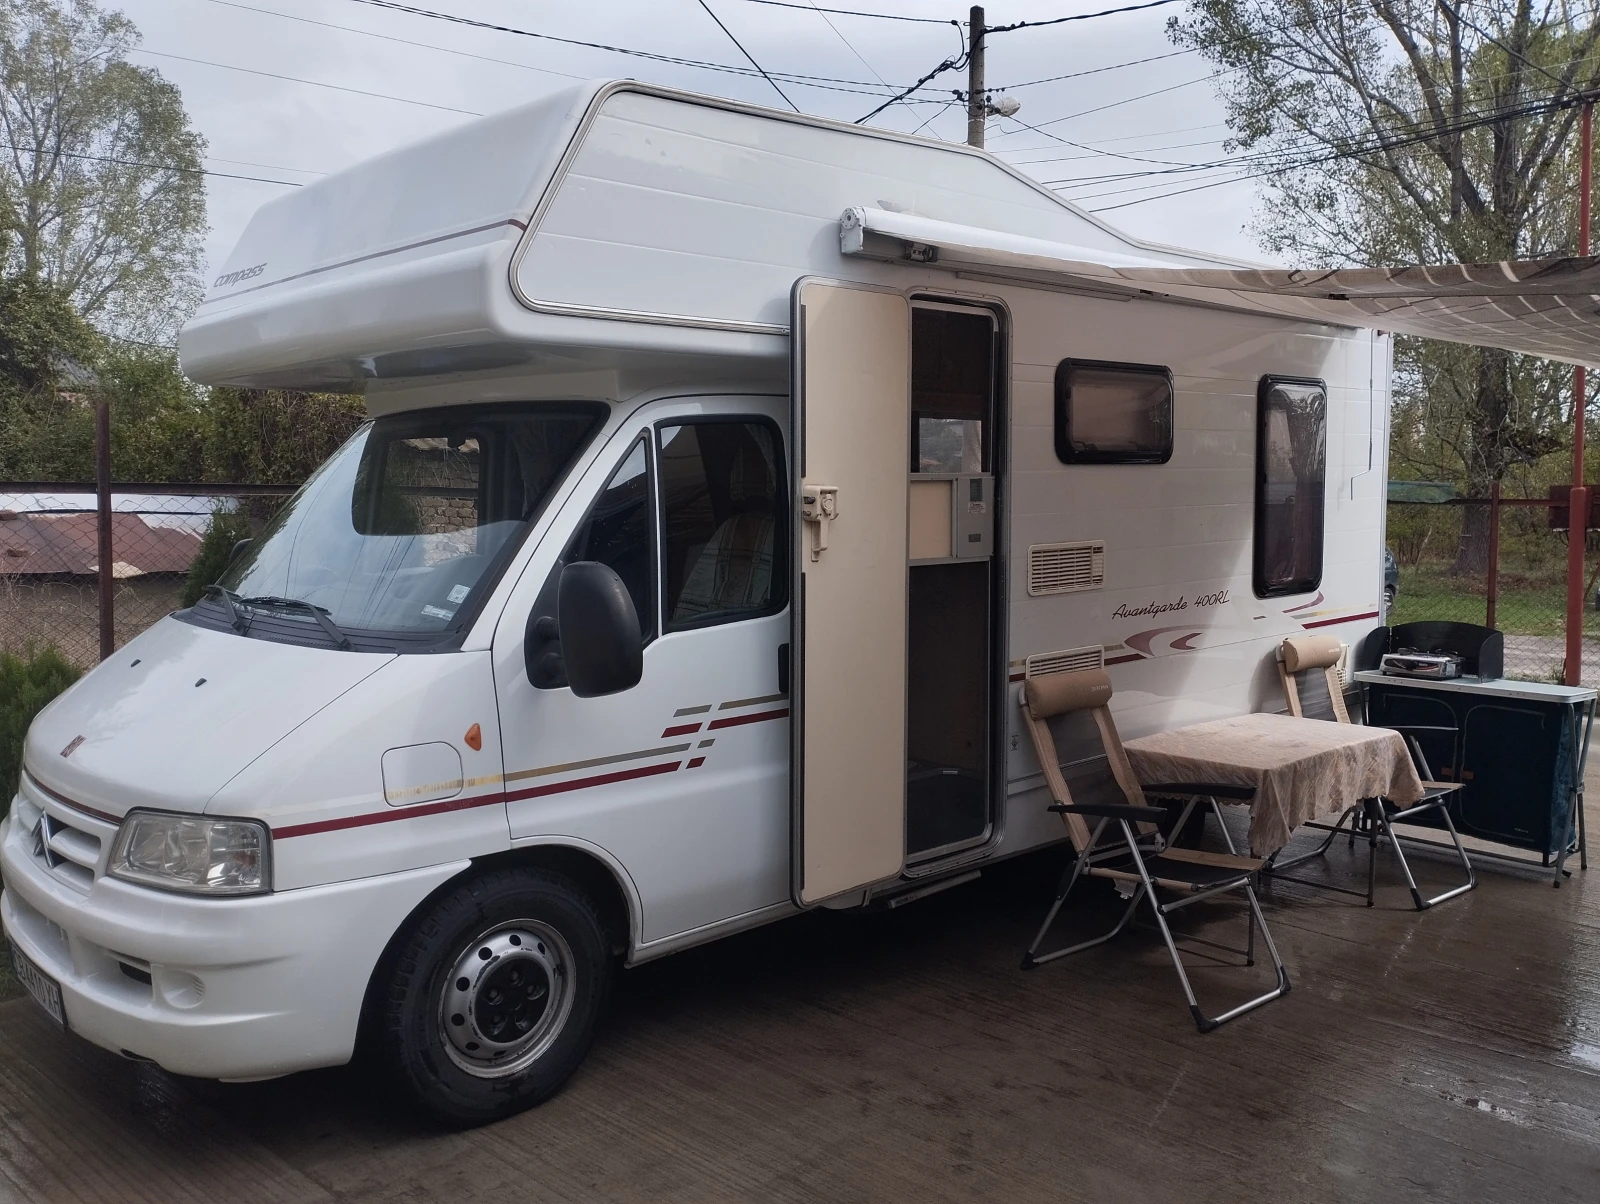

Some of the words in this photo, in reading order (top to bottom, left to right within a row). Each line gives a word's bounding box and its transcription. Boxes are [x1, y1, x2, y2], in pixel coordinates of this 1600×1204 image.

[213, 262, 268, 288] compass
[1111, 595, 1189, 620] Avantgarde
[1193, 589, 1231, 608] 400RL
